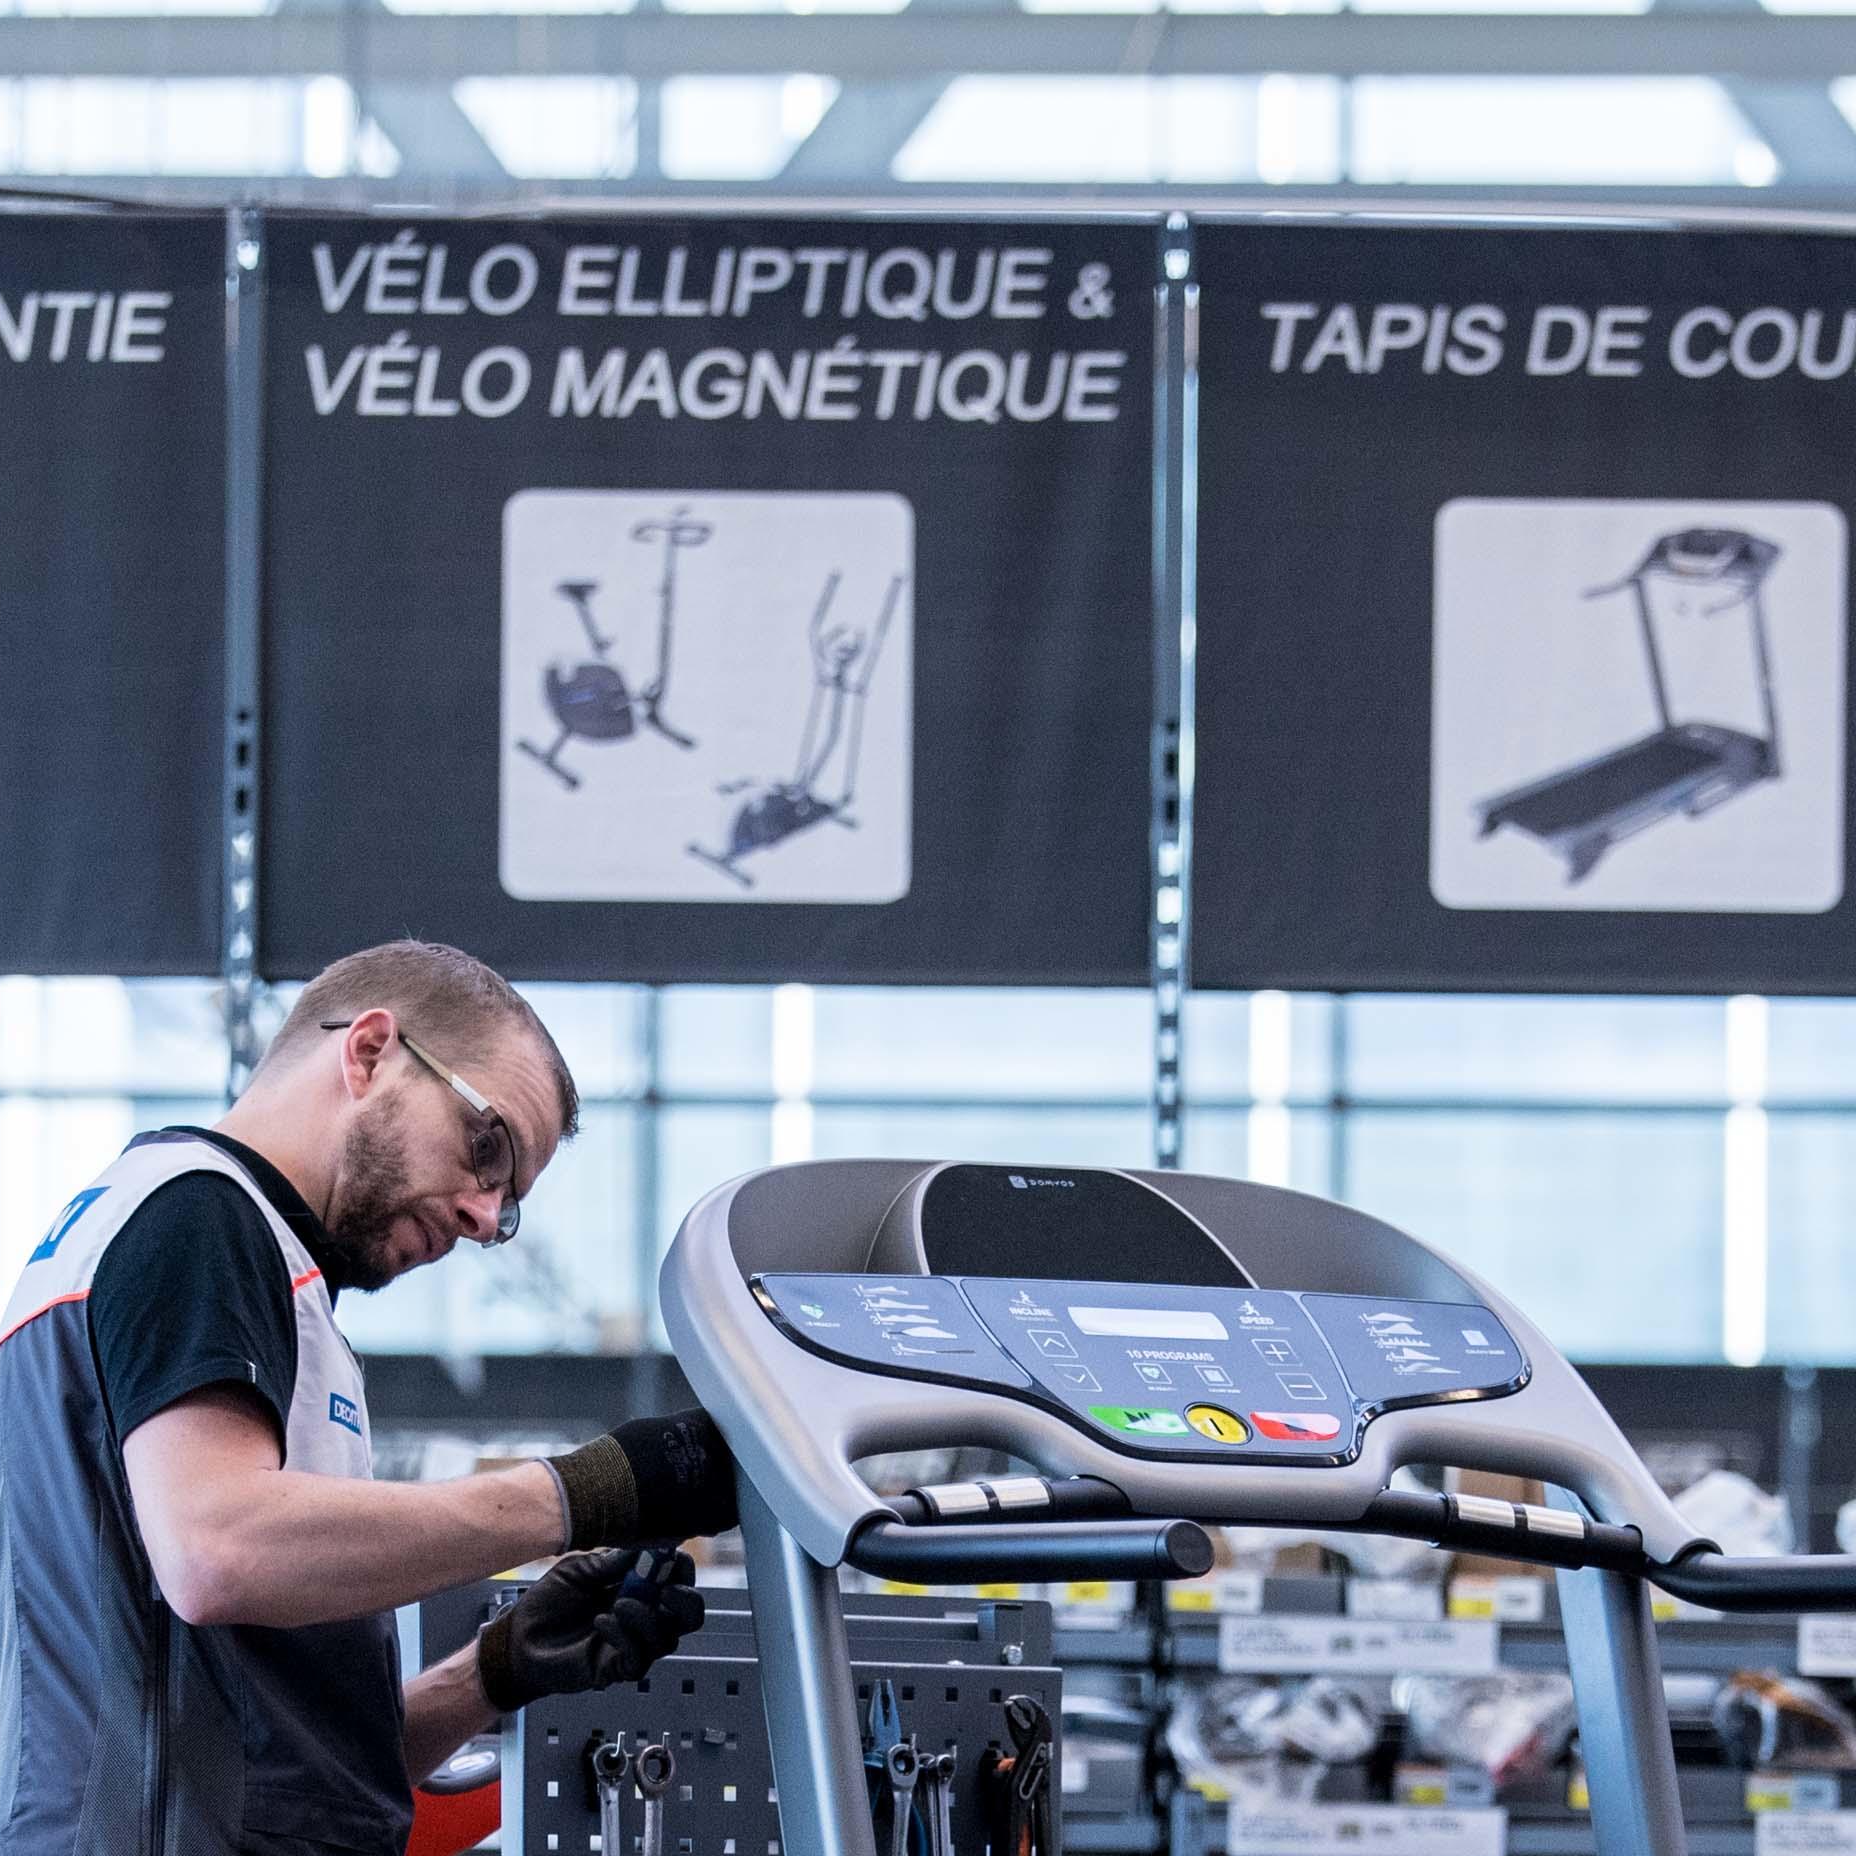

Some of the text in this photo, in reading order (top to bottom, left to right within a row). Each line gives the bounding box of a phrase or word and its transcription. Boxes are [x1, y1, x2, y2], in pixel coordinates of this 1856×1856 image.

[310, 229, 1115, 323] VÉLO ELLIPTIQUE &
[304, 330, 1125, 424] VÉLO MAGNÉTIQUE
[1260, 303, 1506, 376] TAPIS
[1526, 305, 1652, 378] DE
[1144, 1350, 1215, 1363] PROGRAMS
